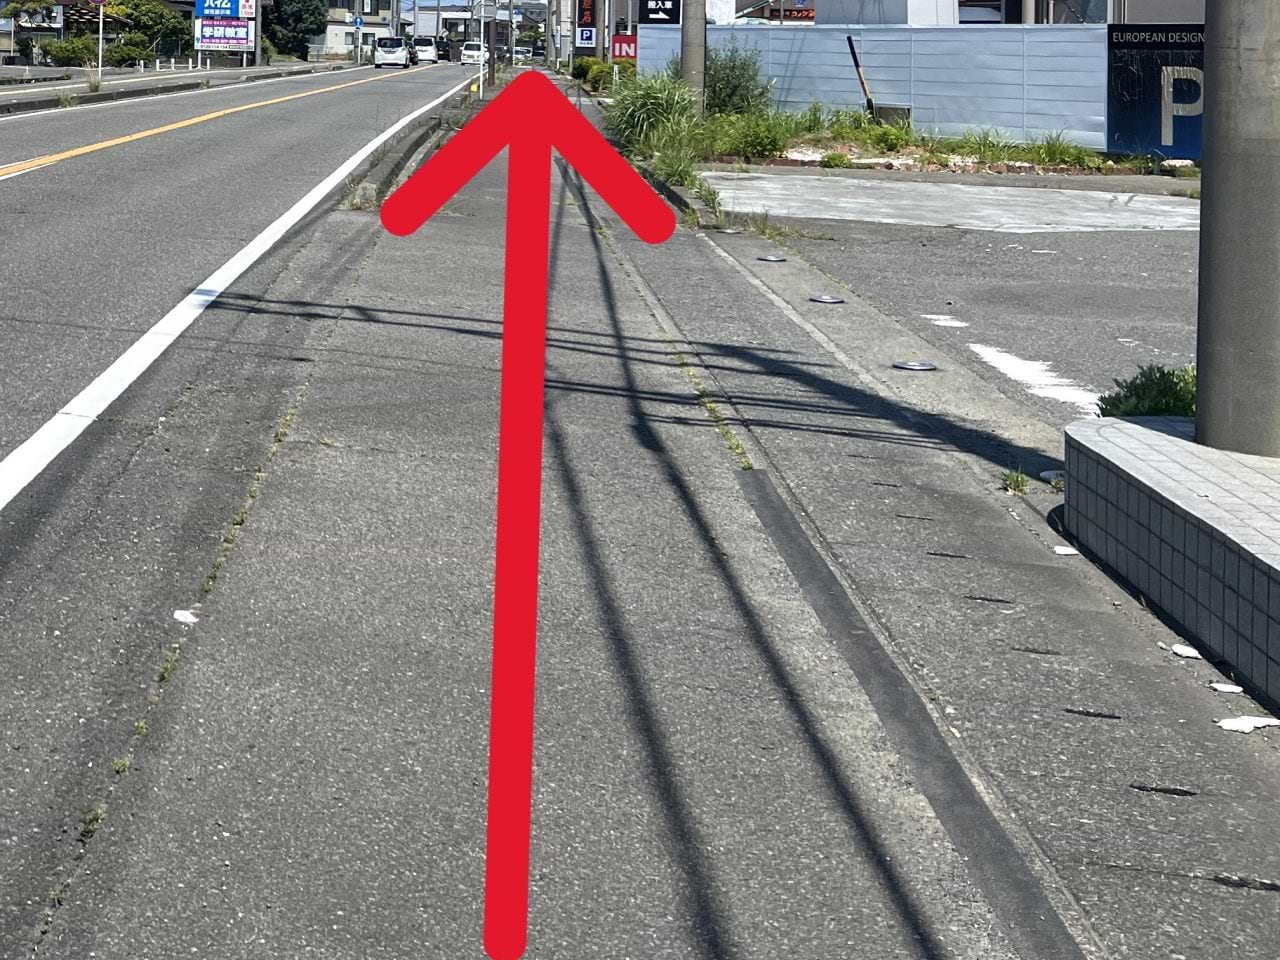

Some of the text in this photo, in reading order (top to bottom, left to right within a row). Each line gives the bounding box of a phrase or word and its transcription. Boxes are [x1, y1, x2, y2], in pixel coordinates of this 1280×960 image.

[202, 26, 248, 38] 学研教室
[582, 30, 591, 40] P
[1112, 32, 1205, 43] EUROPEAN DESIGN
[614, 42, 636, 57] IN
[1161, 66, 1204, 146] P
